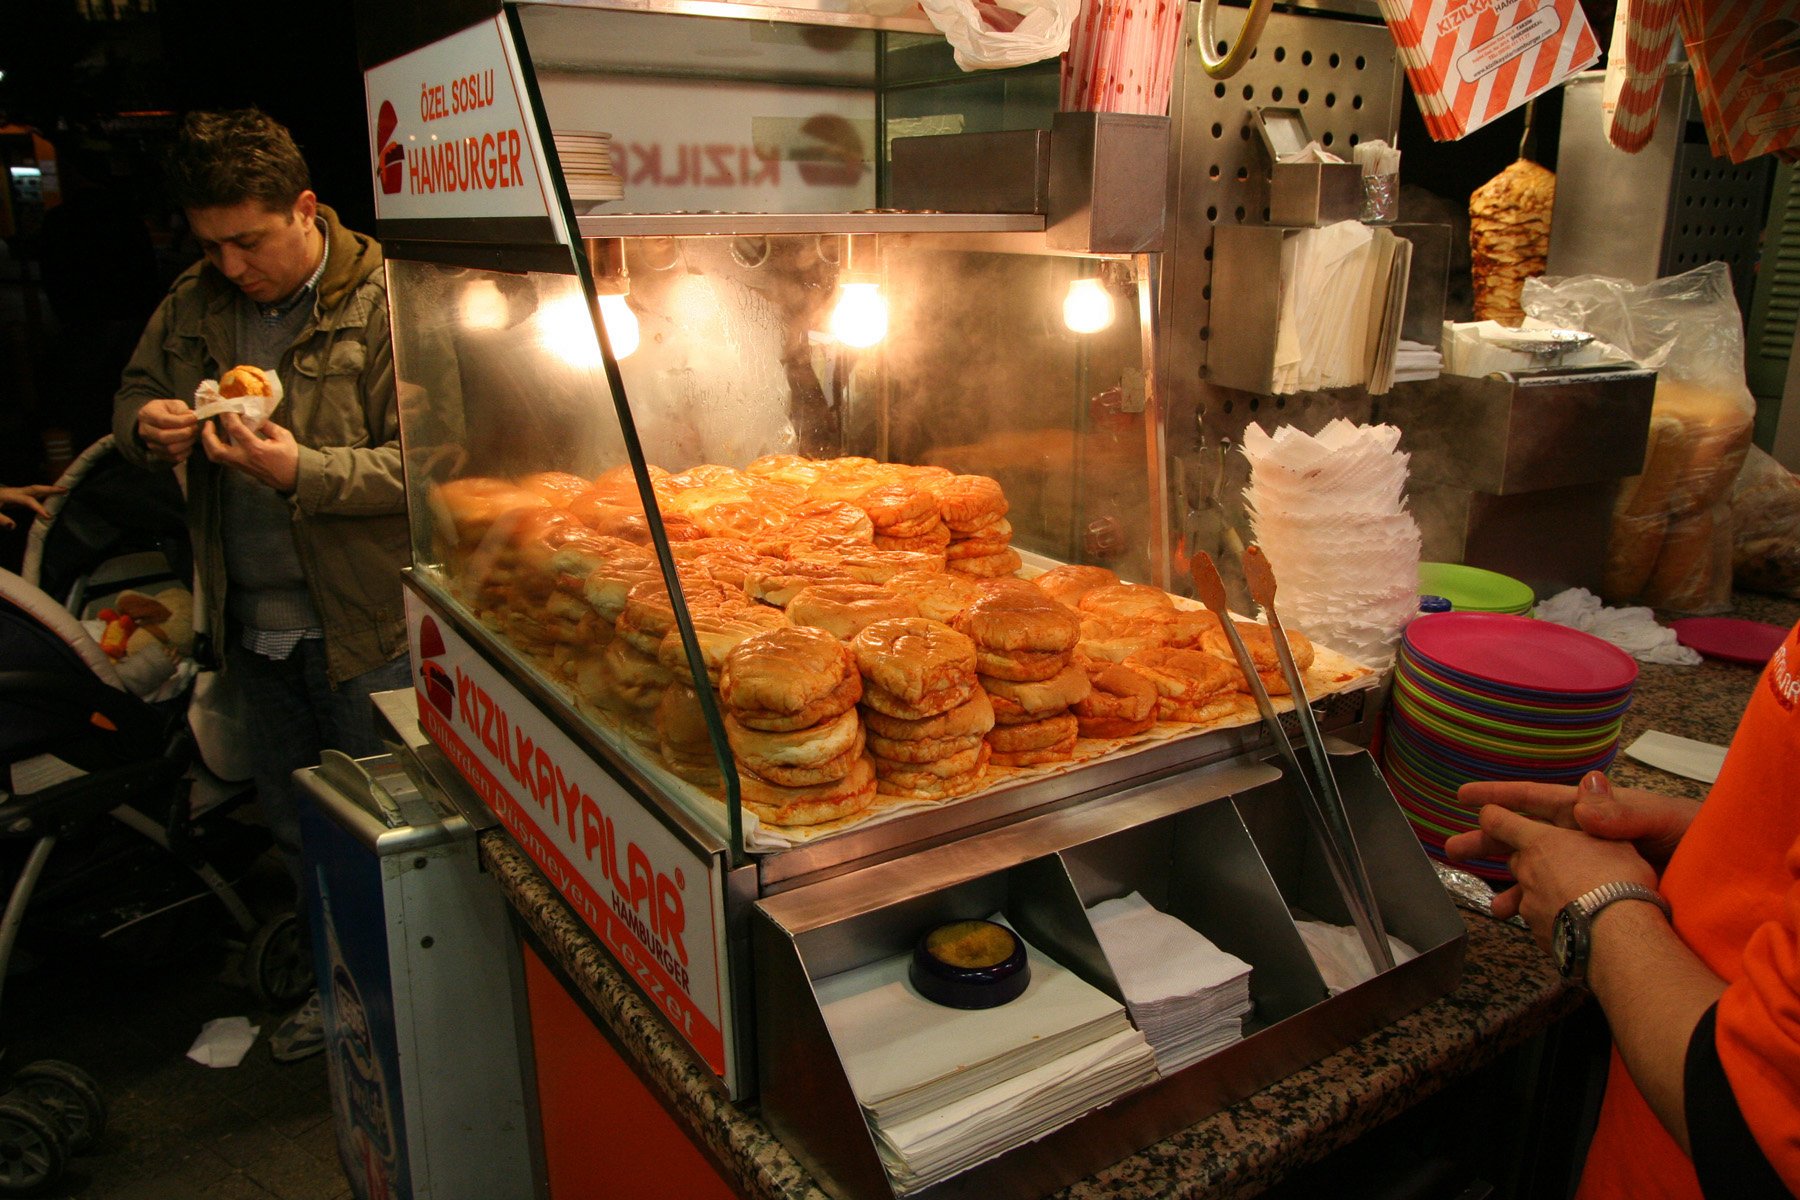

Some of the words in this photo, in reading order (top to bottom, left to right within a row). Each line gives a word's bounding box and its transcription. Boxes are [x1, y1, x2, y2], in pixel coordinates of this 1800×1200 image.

[421, 82, 449, 123] ÖZEL
[452, 68, 494, 115] SOSLU
[408, 129, 524, 195] HAMBURGER
[456, 665, 689, 968] KIZILKAYALAR
[428, 711, 490, 798] Dillerden
[495, 788, 598, 925] Düşmeyen
[606, 918, 694, 1038] Lezzet
[611, 889, 691, 996] HAMBURGER
